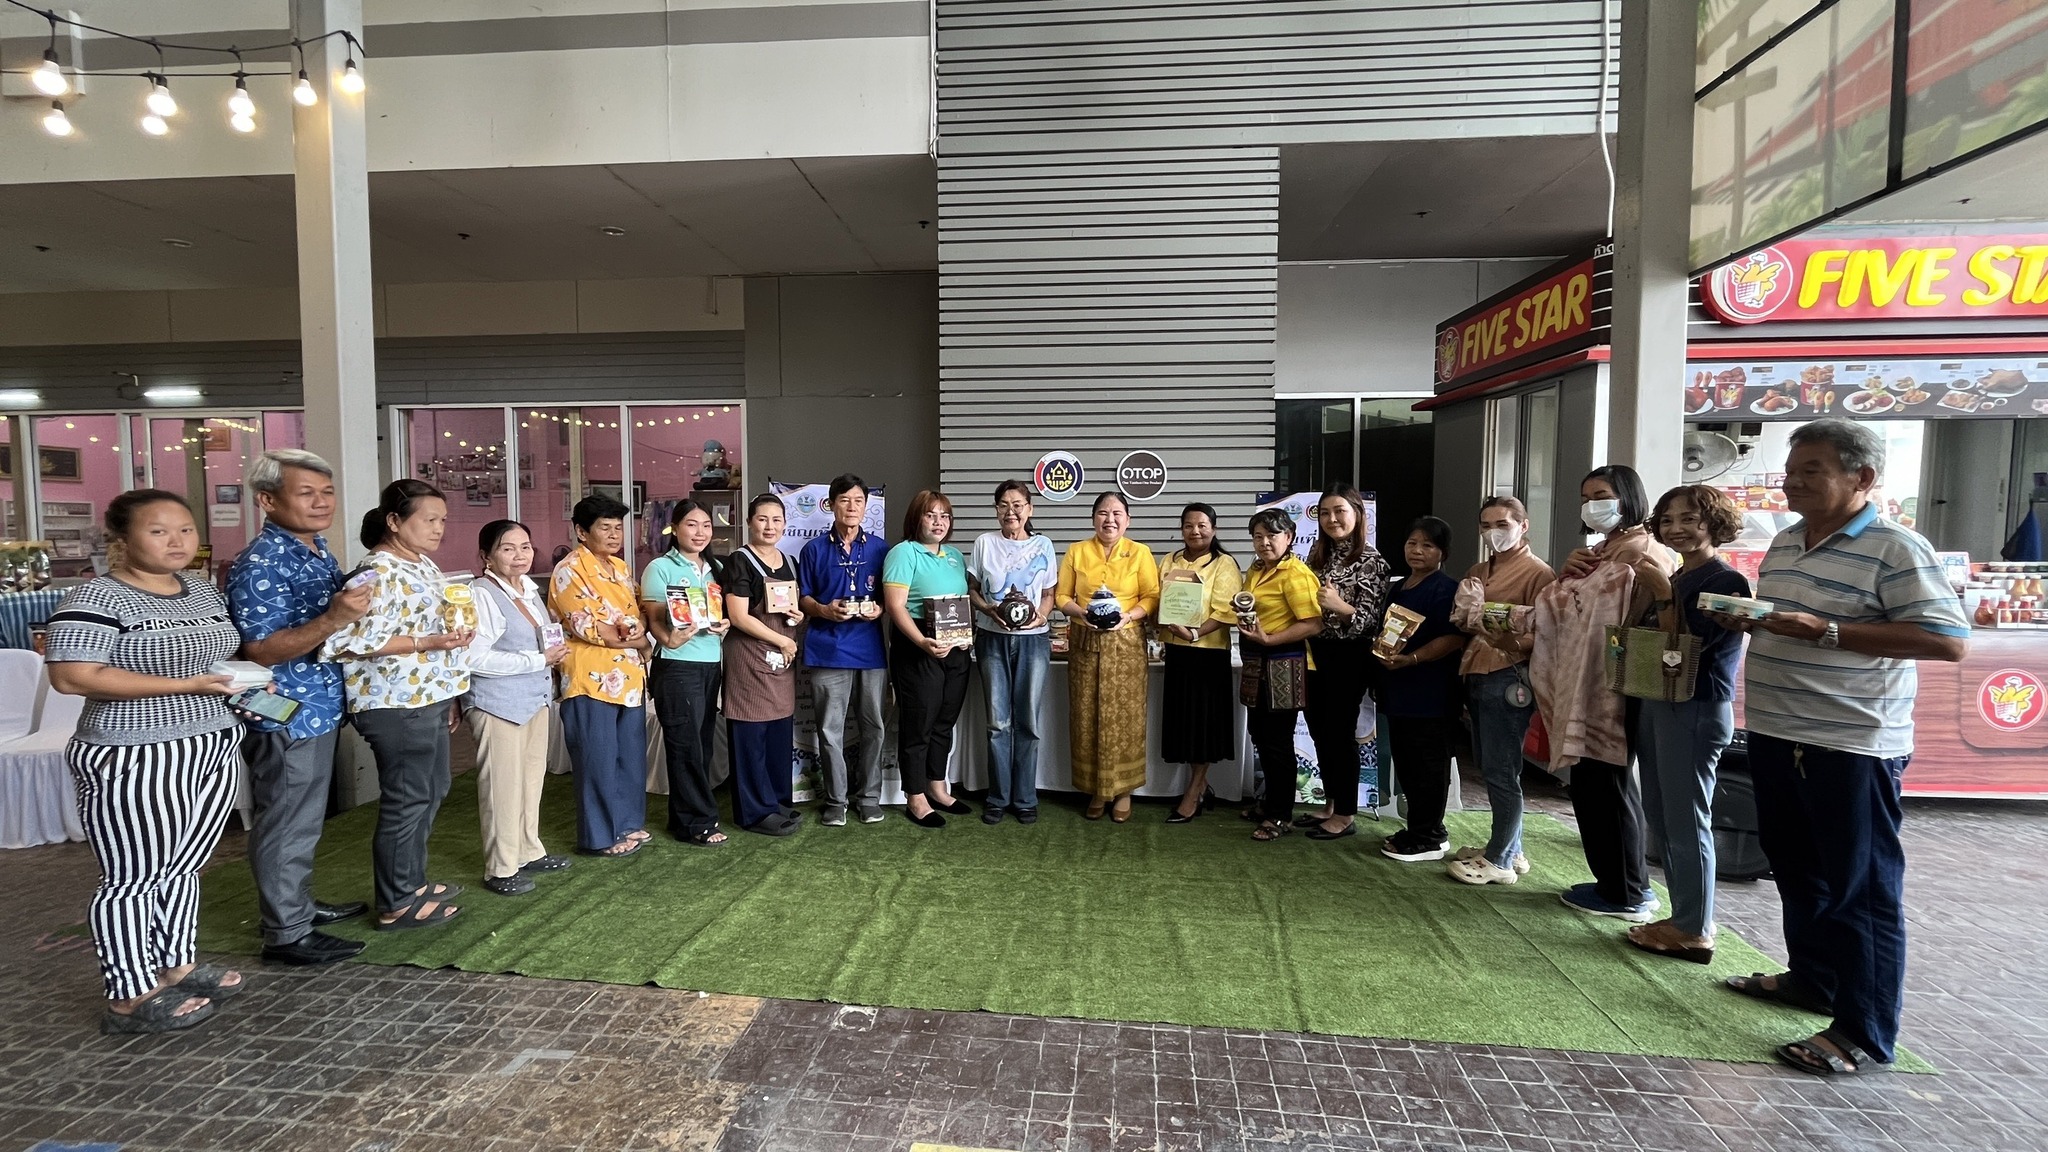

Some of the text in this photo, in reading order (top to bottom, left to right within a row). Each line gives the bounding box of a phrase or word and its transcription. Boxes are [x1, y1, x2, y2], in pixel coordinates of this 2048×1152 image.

[1798, 247, 1958, 309] FIVE
[1460, 273, 1589, 369] FIVE STAR
[1121, 467, 1163, 479] OTOP
[128, 617, 218, 632] CHRISTIAN
